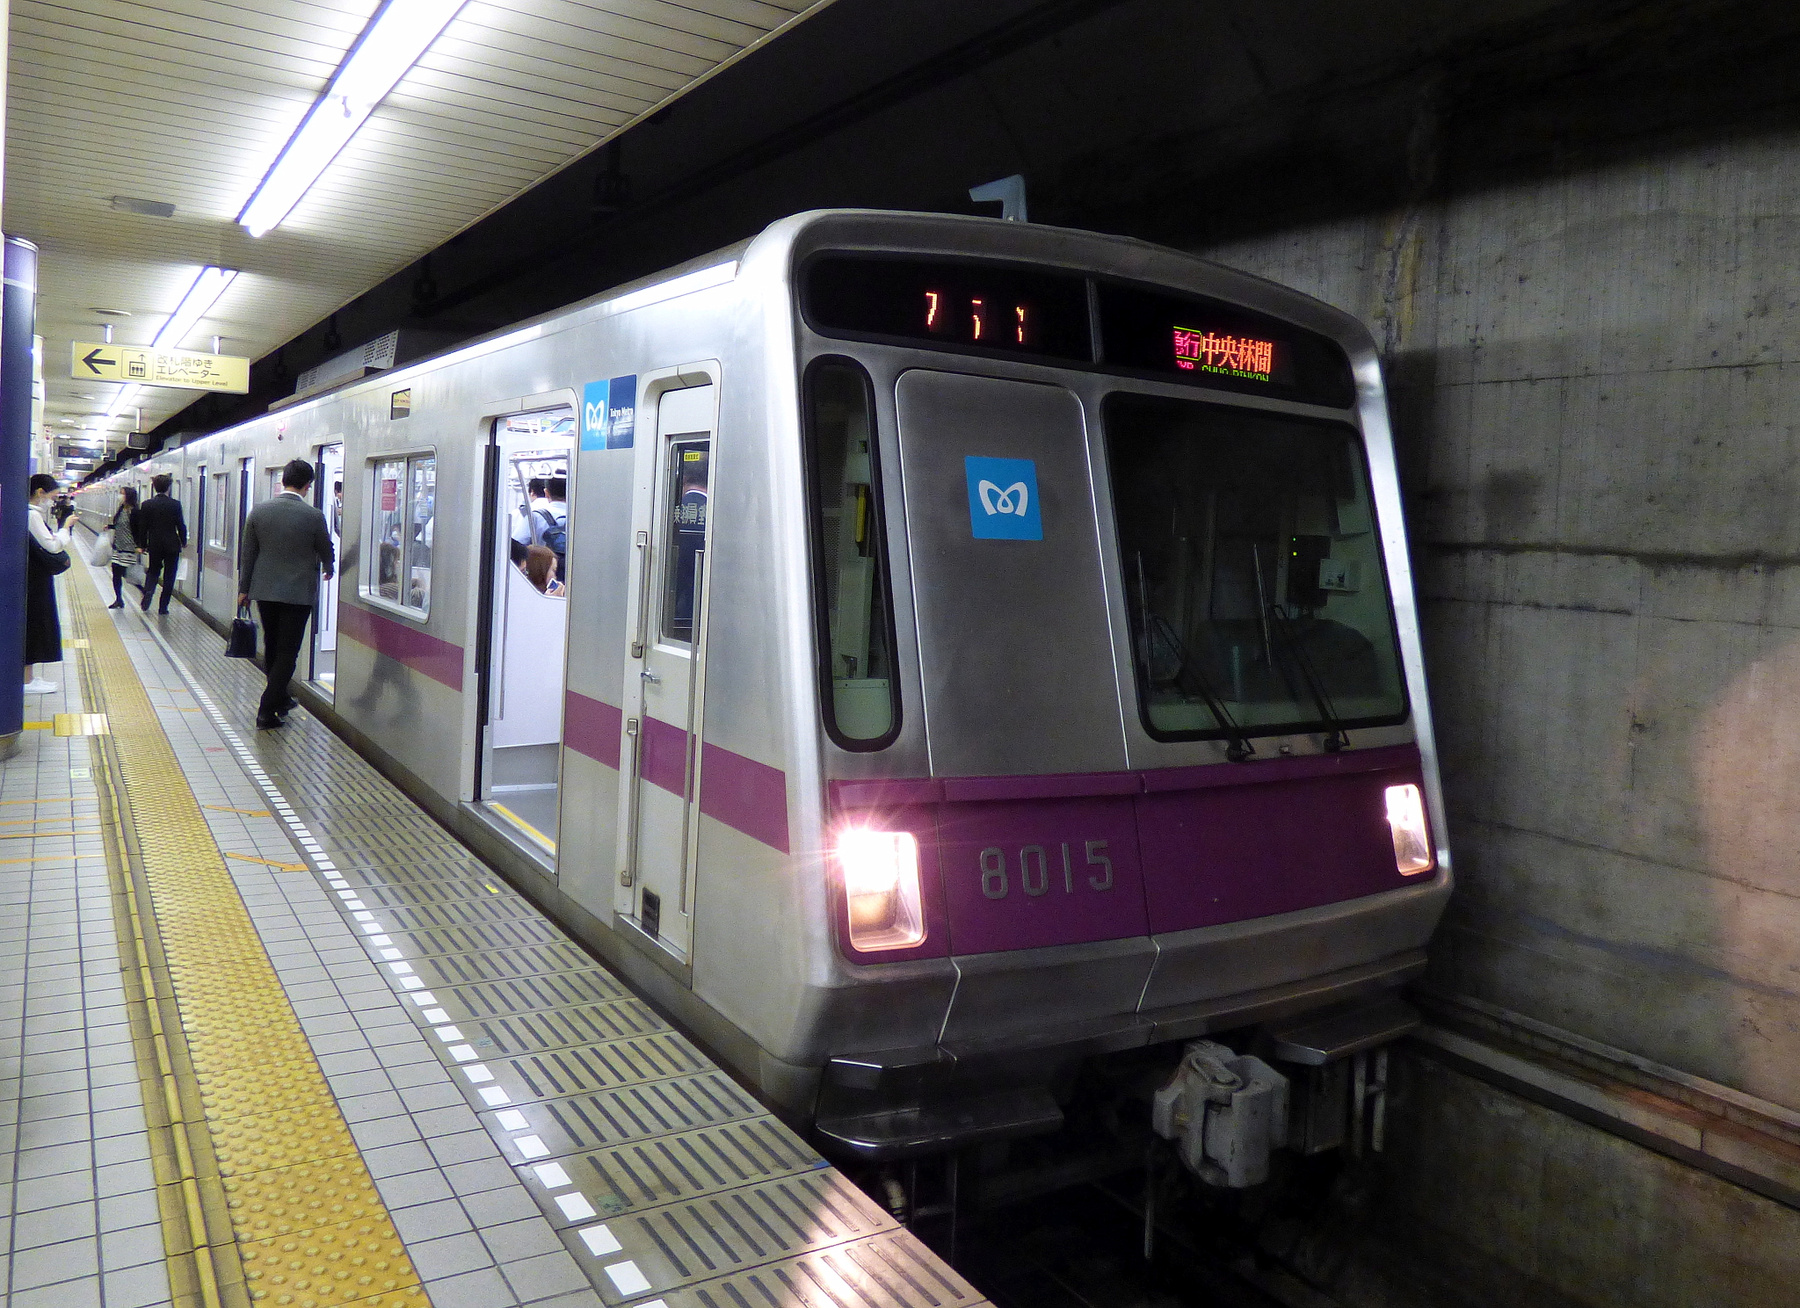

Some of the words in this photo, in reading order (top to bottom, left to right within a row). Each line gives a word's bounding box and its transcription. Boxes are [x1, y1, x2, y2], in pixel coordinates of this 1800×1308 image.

[1201, 332, 1273, 374] 中央林間
[156, 365, 220, 379] エレベーター
[610, 408, 621, 418] Tokyo
[980, 840, 1114, 900] 8015
